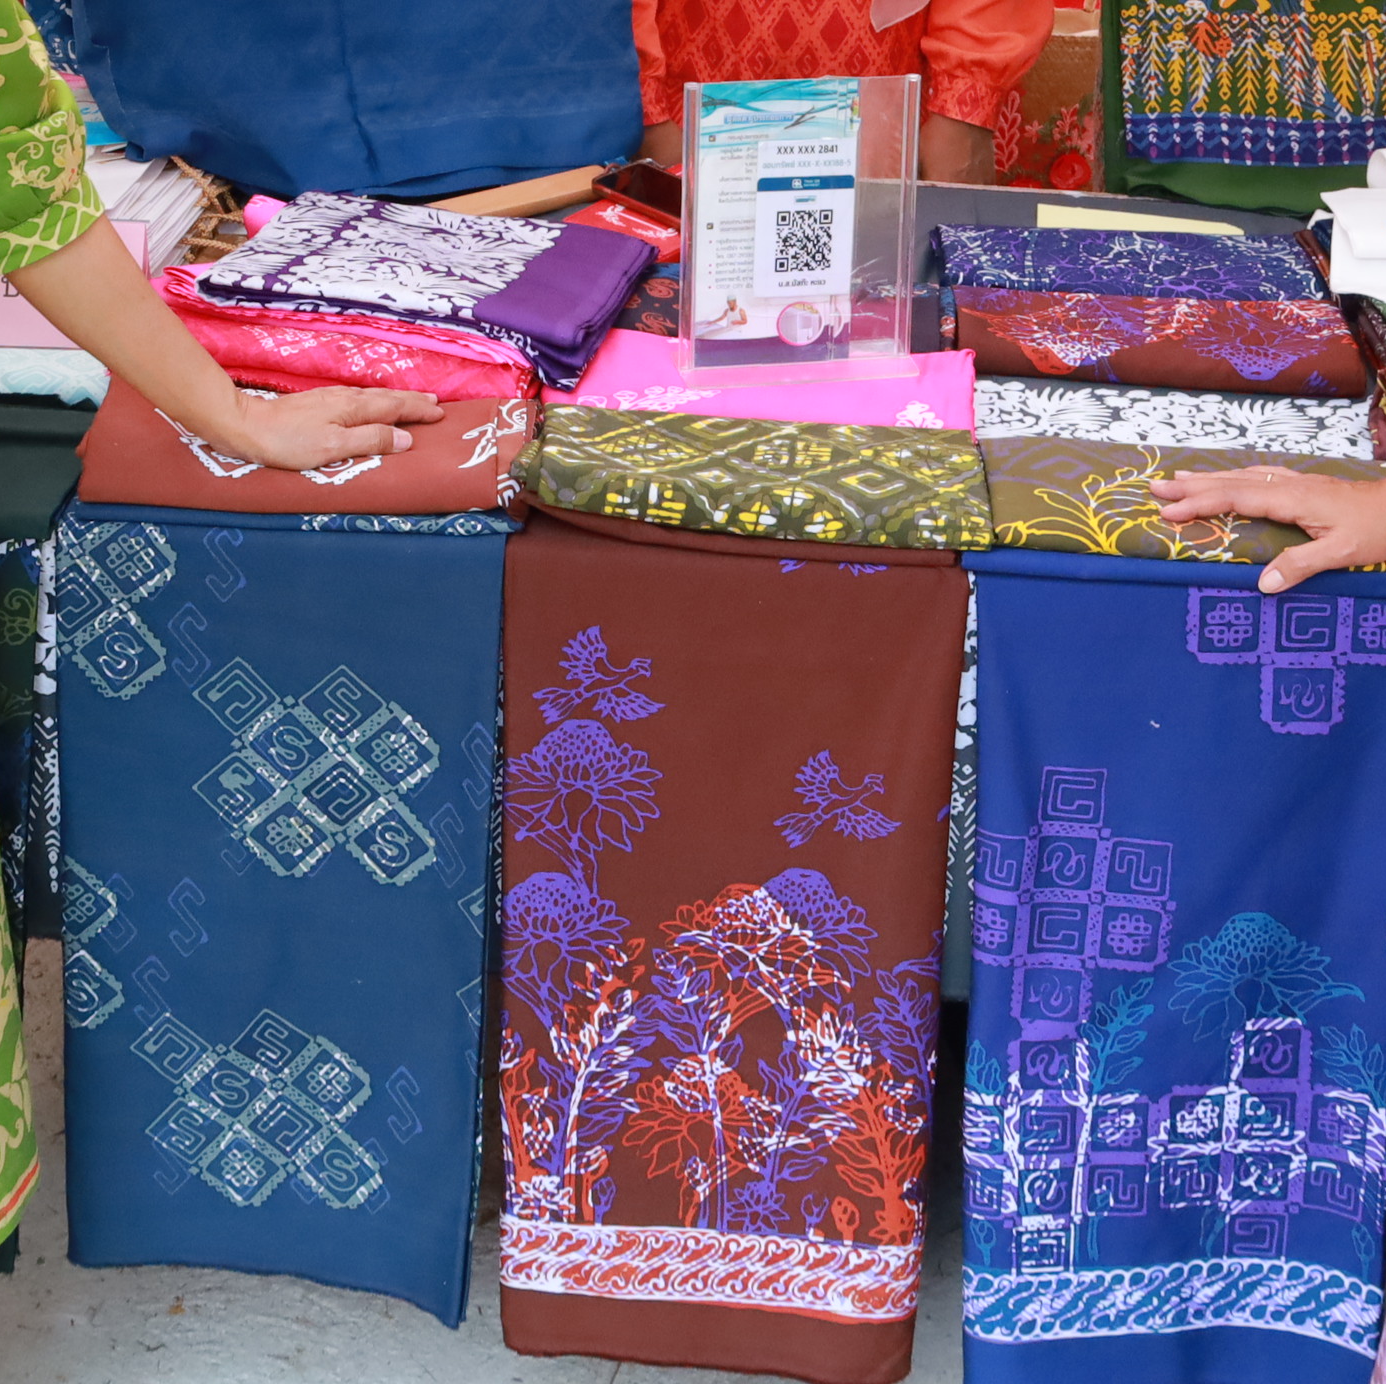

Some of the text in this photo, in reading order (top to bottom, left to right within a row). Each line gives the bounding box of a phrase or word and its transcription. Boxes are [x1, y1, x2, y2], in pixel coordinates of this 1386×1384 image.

[776, 144, 839, 155] XXX XXX 2841
